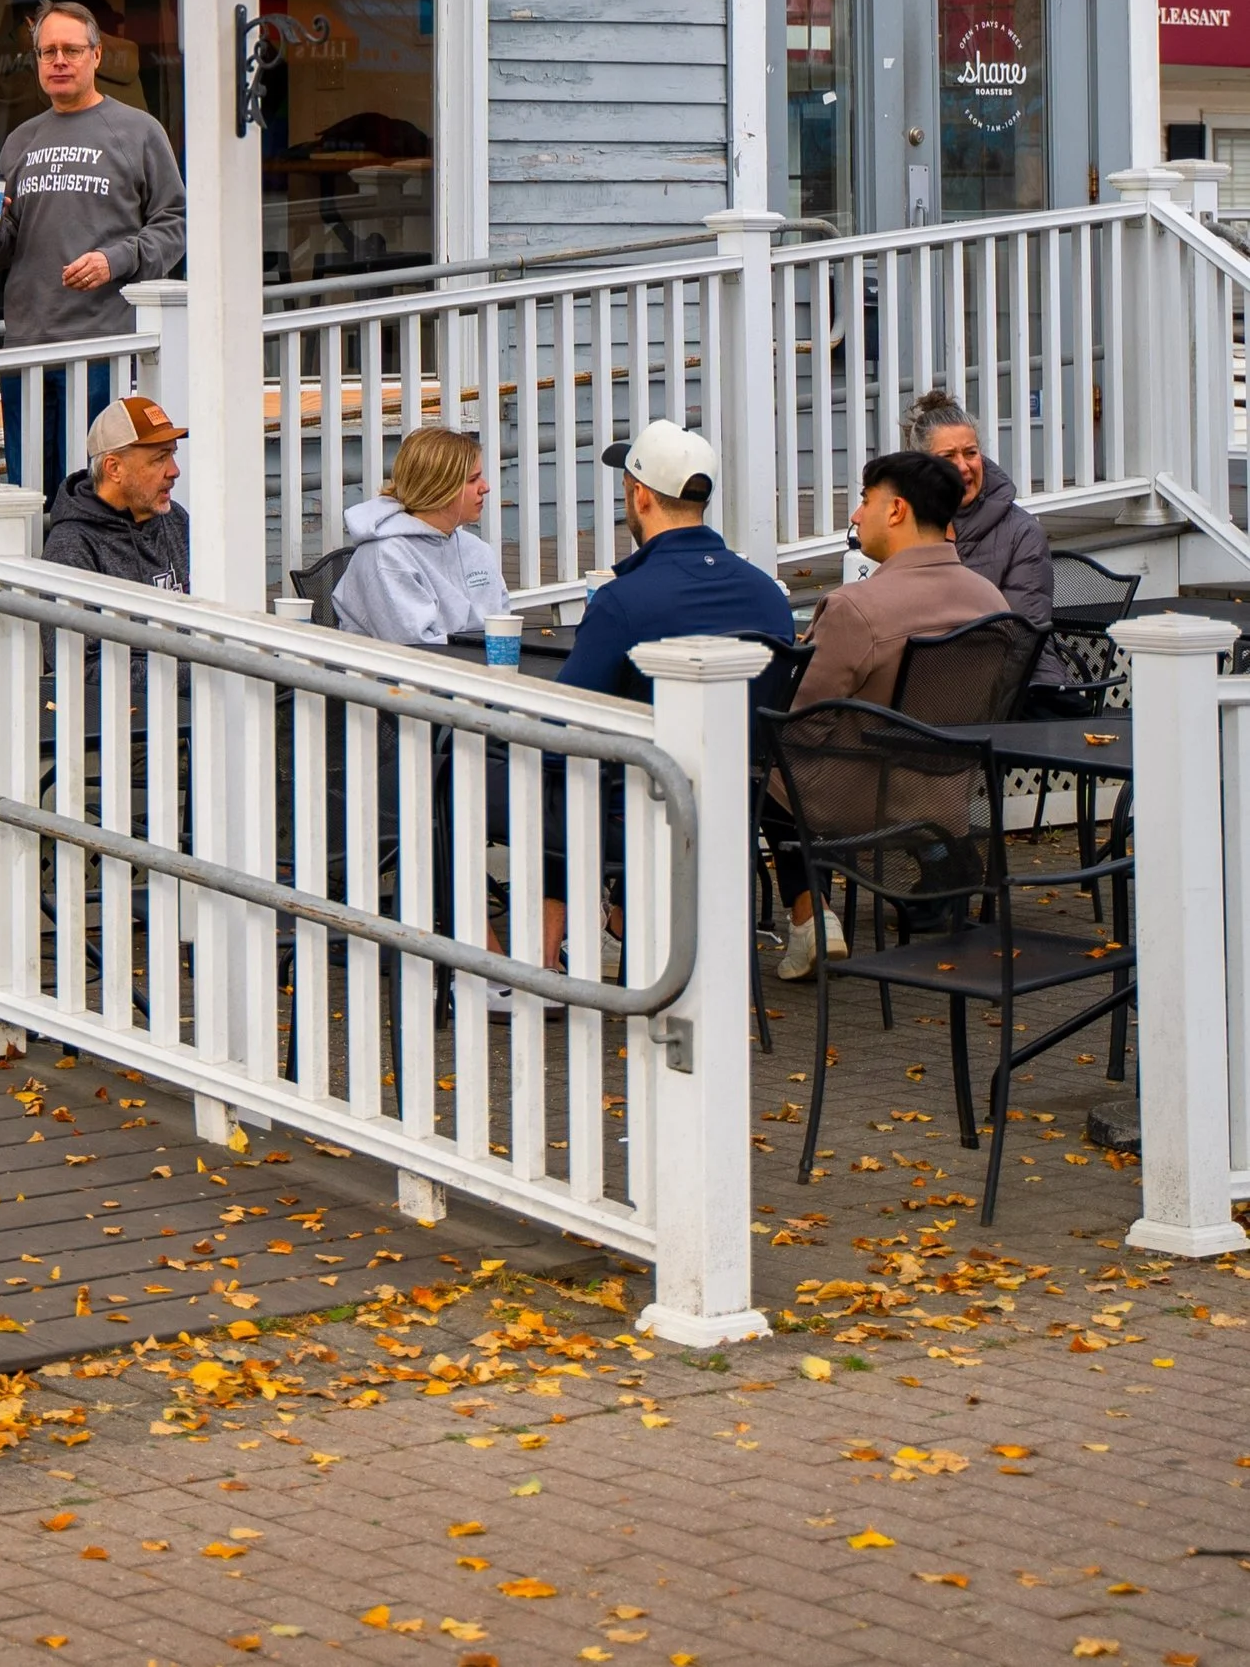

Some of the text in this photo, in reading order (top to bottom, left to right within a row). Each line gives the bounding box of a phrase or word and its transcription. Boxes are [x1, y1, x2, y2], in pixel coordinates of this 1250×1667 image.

[1156, 7, 1231, 27] LEASANT
[959, 29, 974, 49] OPEN
[981, 20, 998, 29] DAYS
[1007, 28, 1023, 50] WEEK
[957, 50, 1027, 84] share
[975, 87, 1013, 96] ROASTERS
[964, 109, 983, 129] FROM
[26, 146, 102, 167] UNIVERSITY
[50, 163, 63, 173] OF
